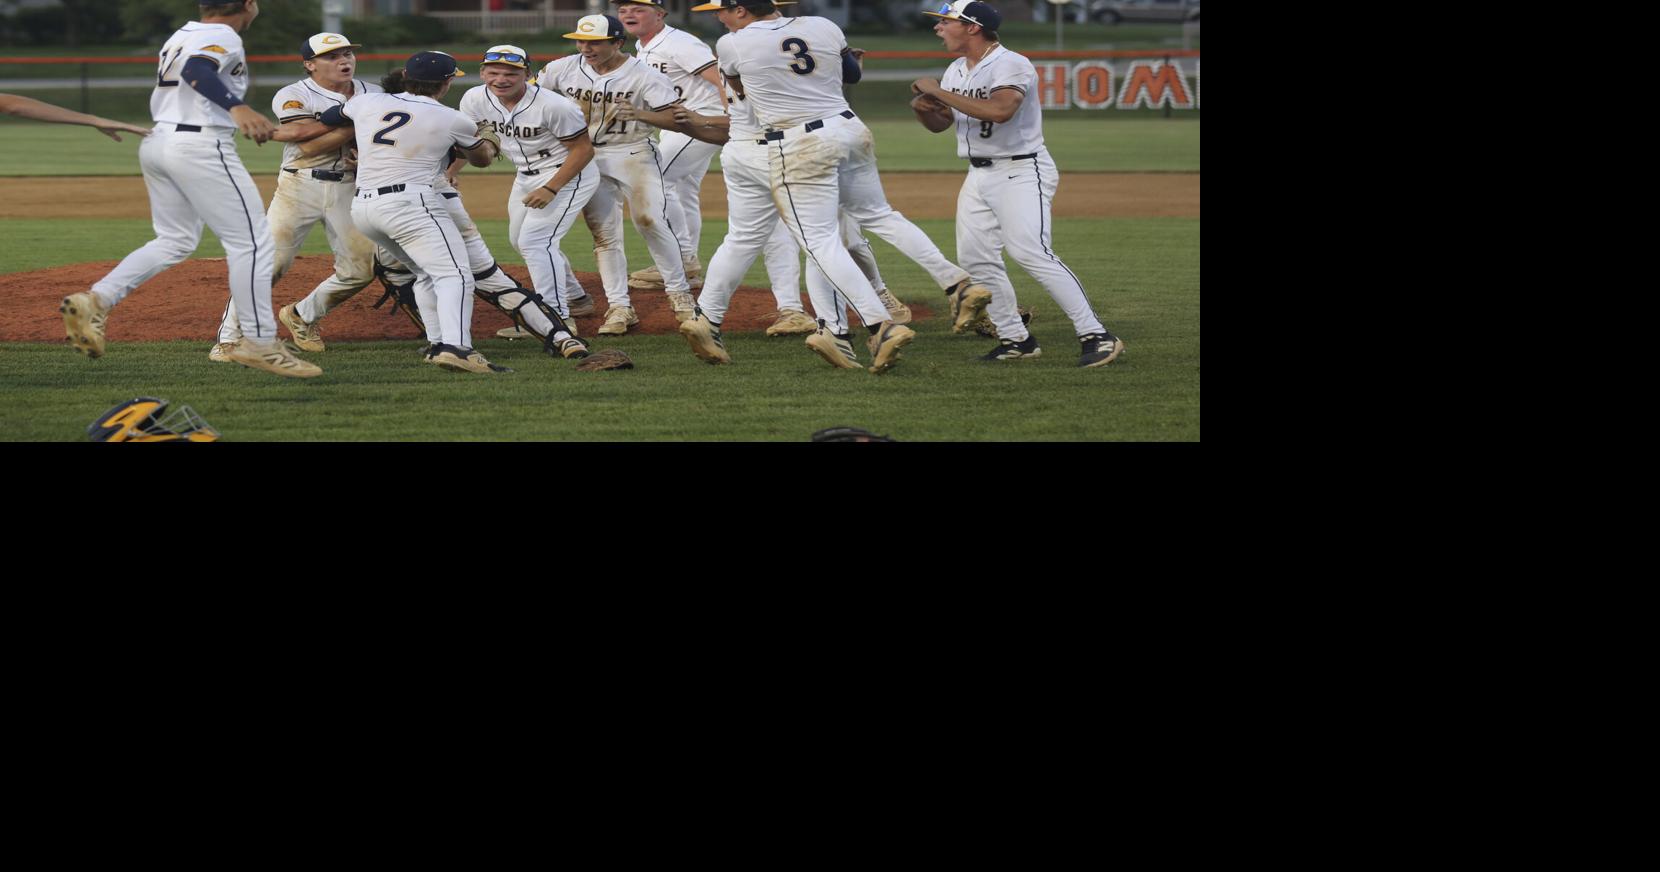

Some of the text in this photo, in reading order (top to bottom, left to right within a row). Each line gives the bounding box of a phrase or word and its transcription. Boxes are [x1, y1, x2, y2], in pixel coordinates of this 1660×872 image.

[781, 37, 816, 75] 3
[1034, 60, 1200, 109] HOM
[372, 111, 412, 147] 2
[605, 117, 628, 135] 21
[979, 120, 994, 138] 9
